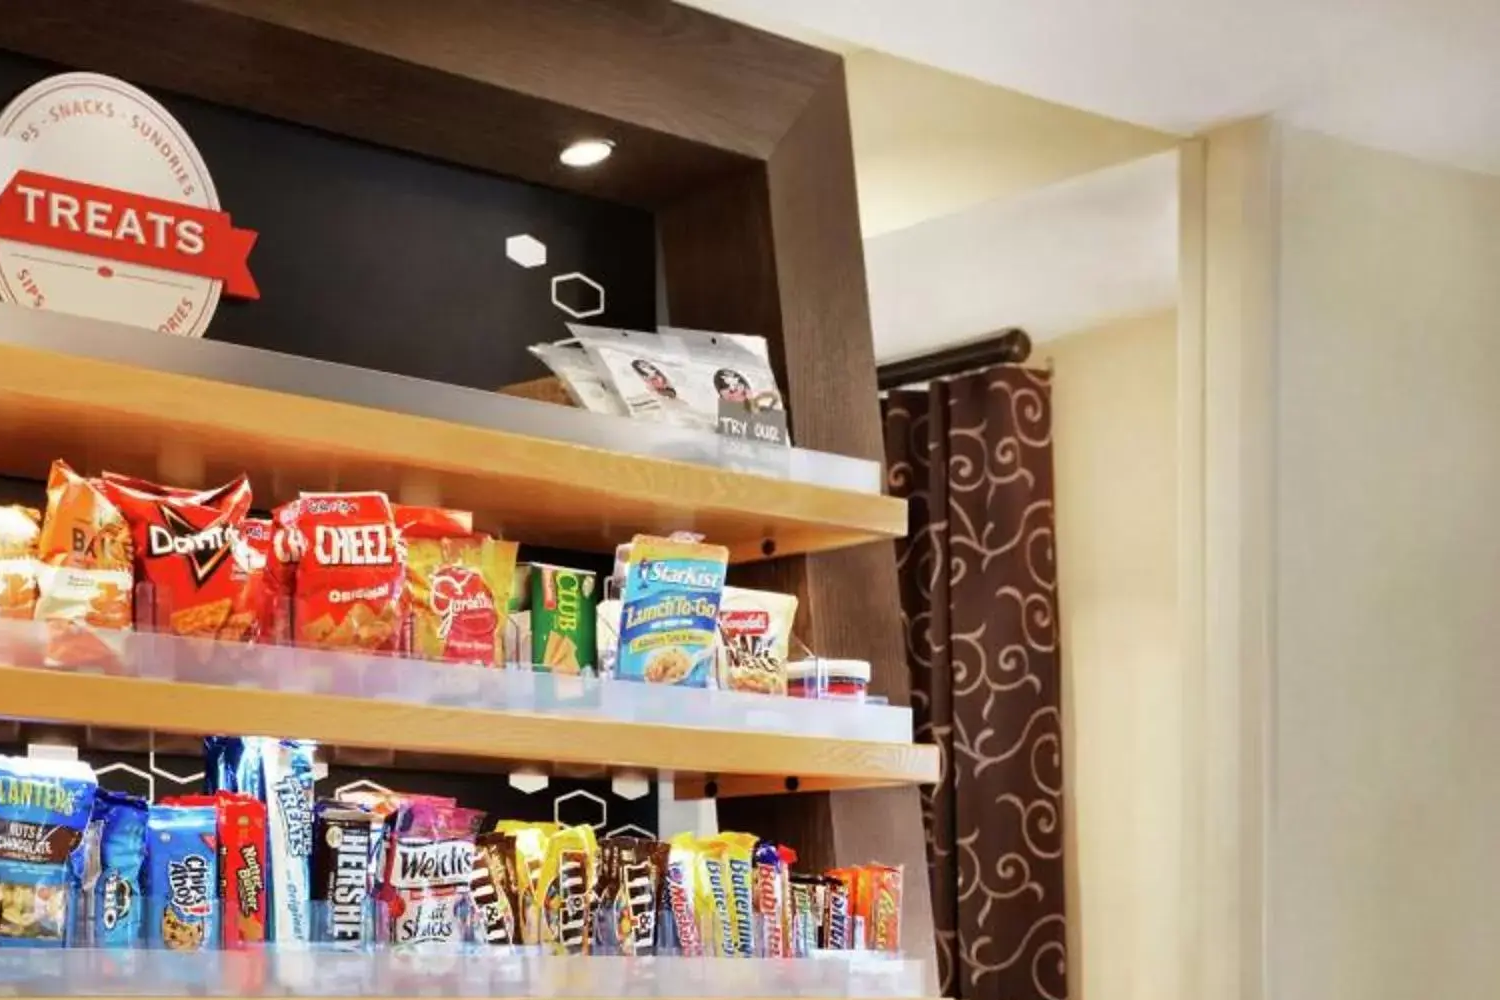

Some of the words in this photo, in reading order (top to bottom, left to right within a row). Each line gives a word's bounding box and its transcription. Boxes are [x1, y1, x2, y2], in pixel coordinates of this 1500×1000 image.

[48, 98, 116, 123] SNACKS
[130, 113, 196, 198] SUNDRIES
[15, 183, 206, 256] TREATS
[556, 570, 580, 632] CLUB
[275, 776, 305, 858] TREATS
[399, 846, 474, 880] Welch's
